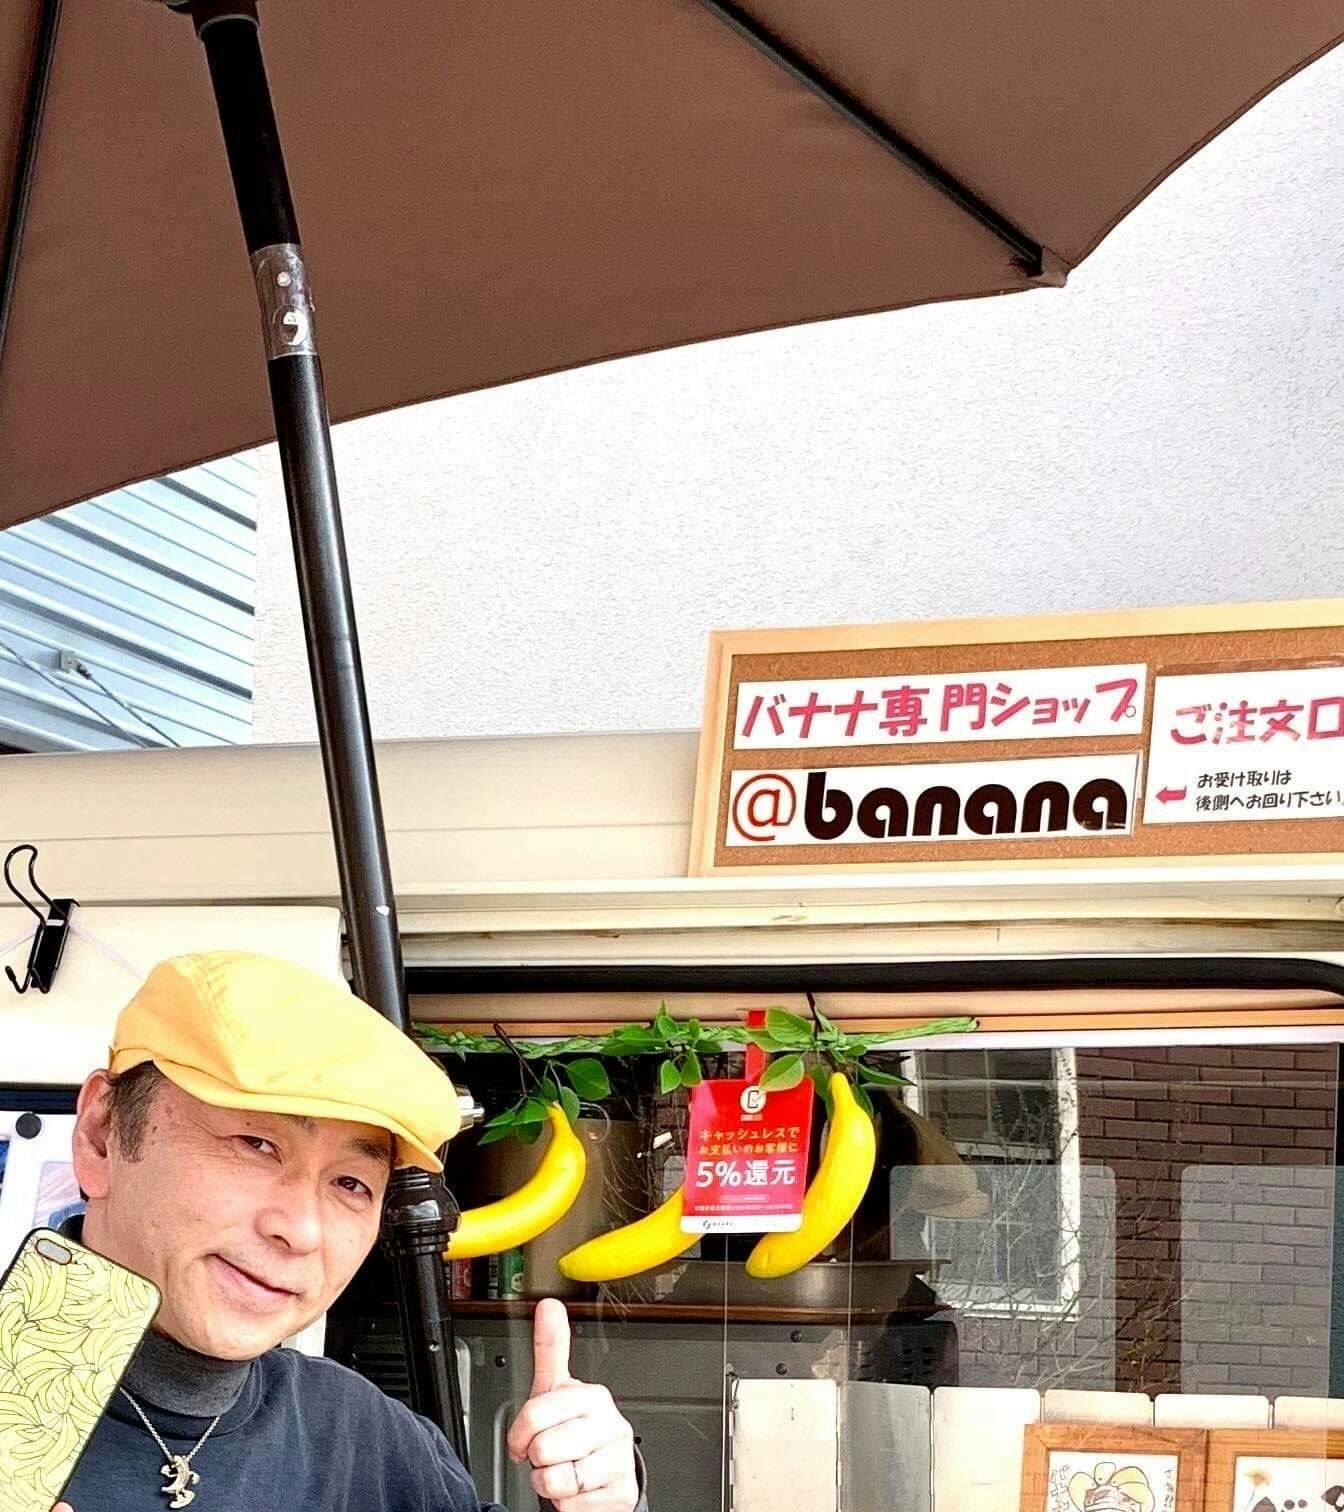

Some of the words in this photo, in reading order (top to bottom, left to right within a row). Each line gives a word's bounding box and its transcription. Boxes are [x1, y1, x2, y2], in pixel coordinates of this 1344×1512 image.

[741, 677, 1139, 739] バナナ専門ショップ
[1197, 770, 1293, 790] お受け取りは
[731, 770, 1127, 844] @banana
[700, 1126, 800, 1141] キャッシュレスで
[695, 1159, 796, 1188] 5%還元
